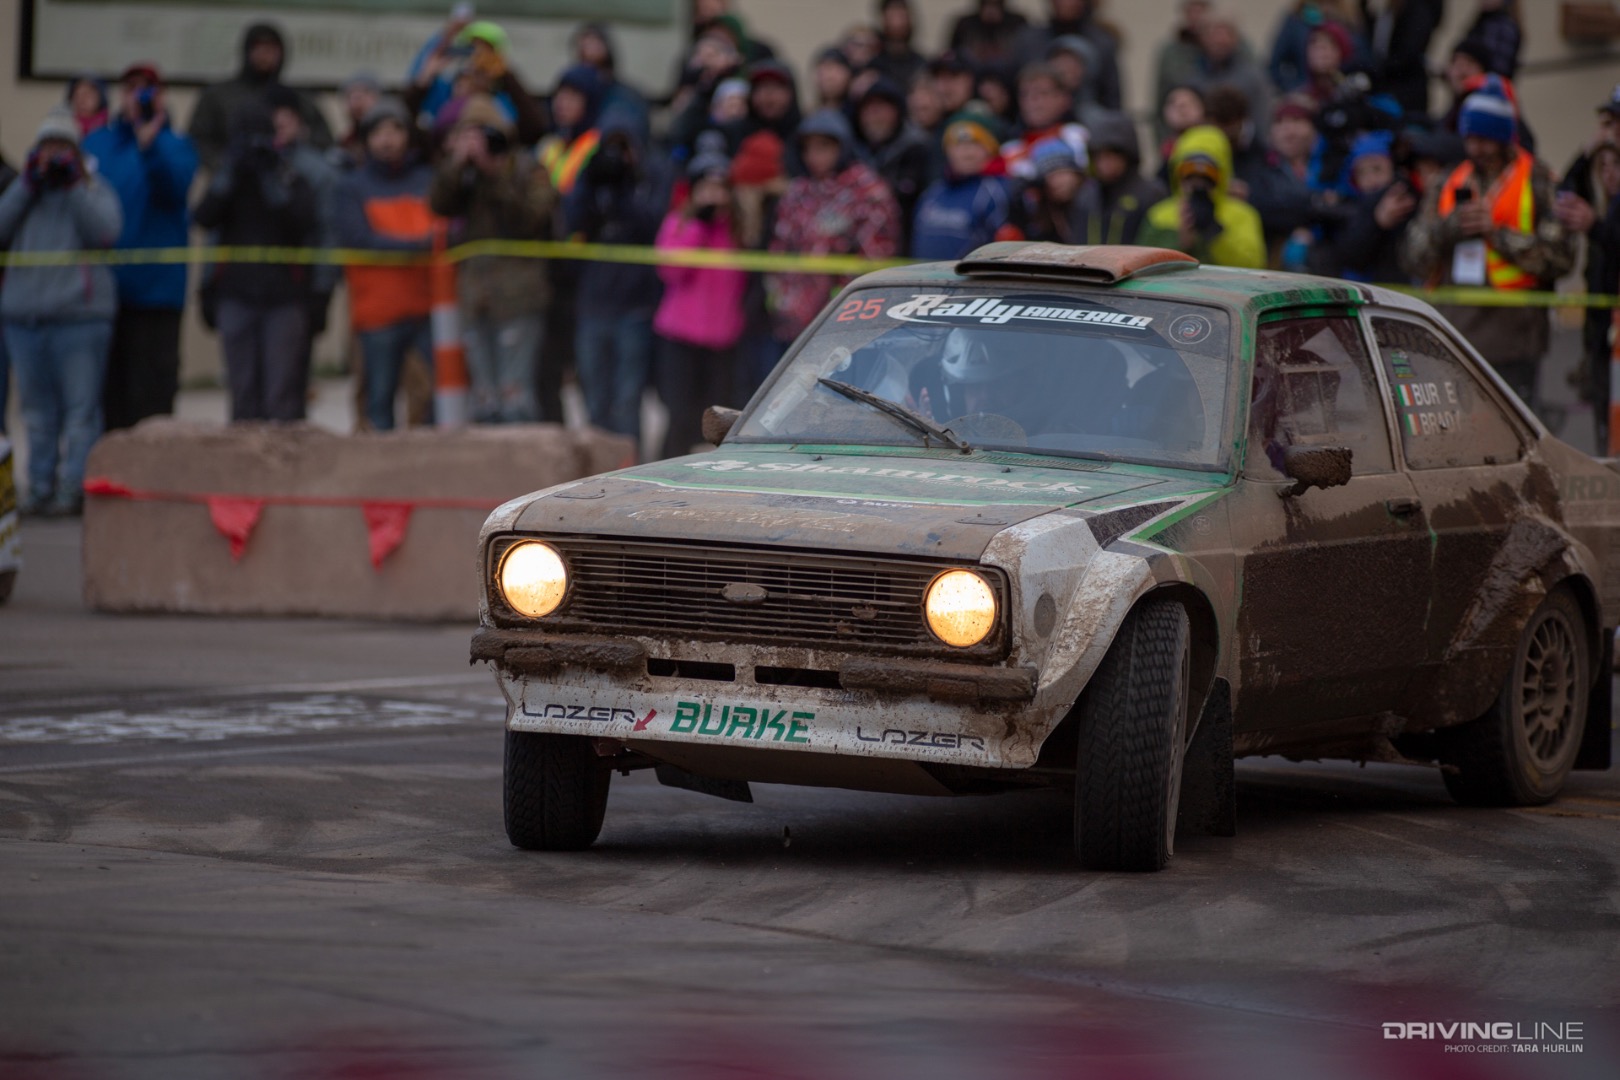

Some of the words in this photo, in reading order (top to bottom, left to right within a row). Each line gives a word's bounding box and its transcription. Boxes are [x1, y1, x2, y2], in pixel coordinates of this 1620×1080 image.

[837, 298, 885, 322] 25
[886, 294, 1025, 324] Rally
[1020, 305, 1153, 330] AMERICA
[522, 702, 636, 723] LAZER
[669, 701, 816, 743] BURKE
[857, 726, 985, 751] LAZER
